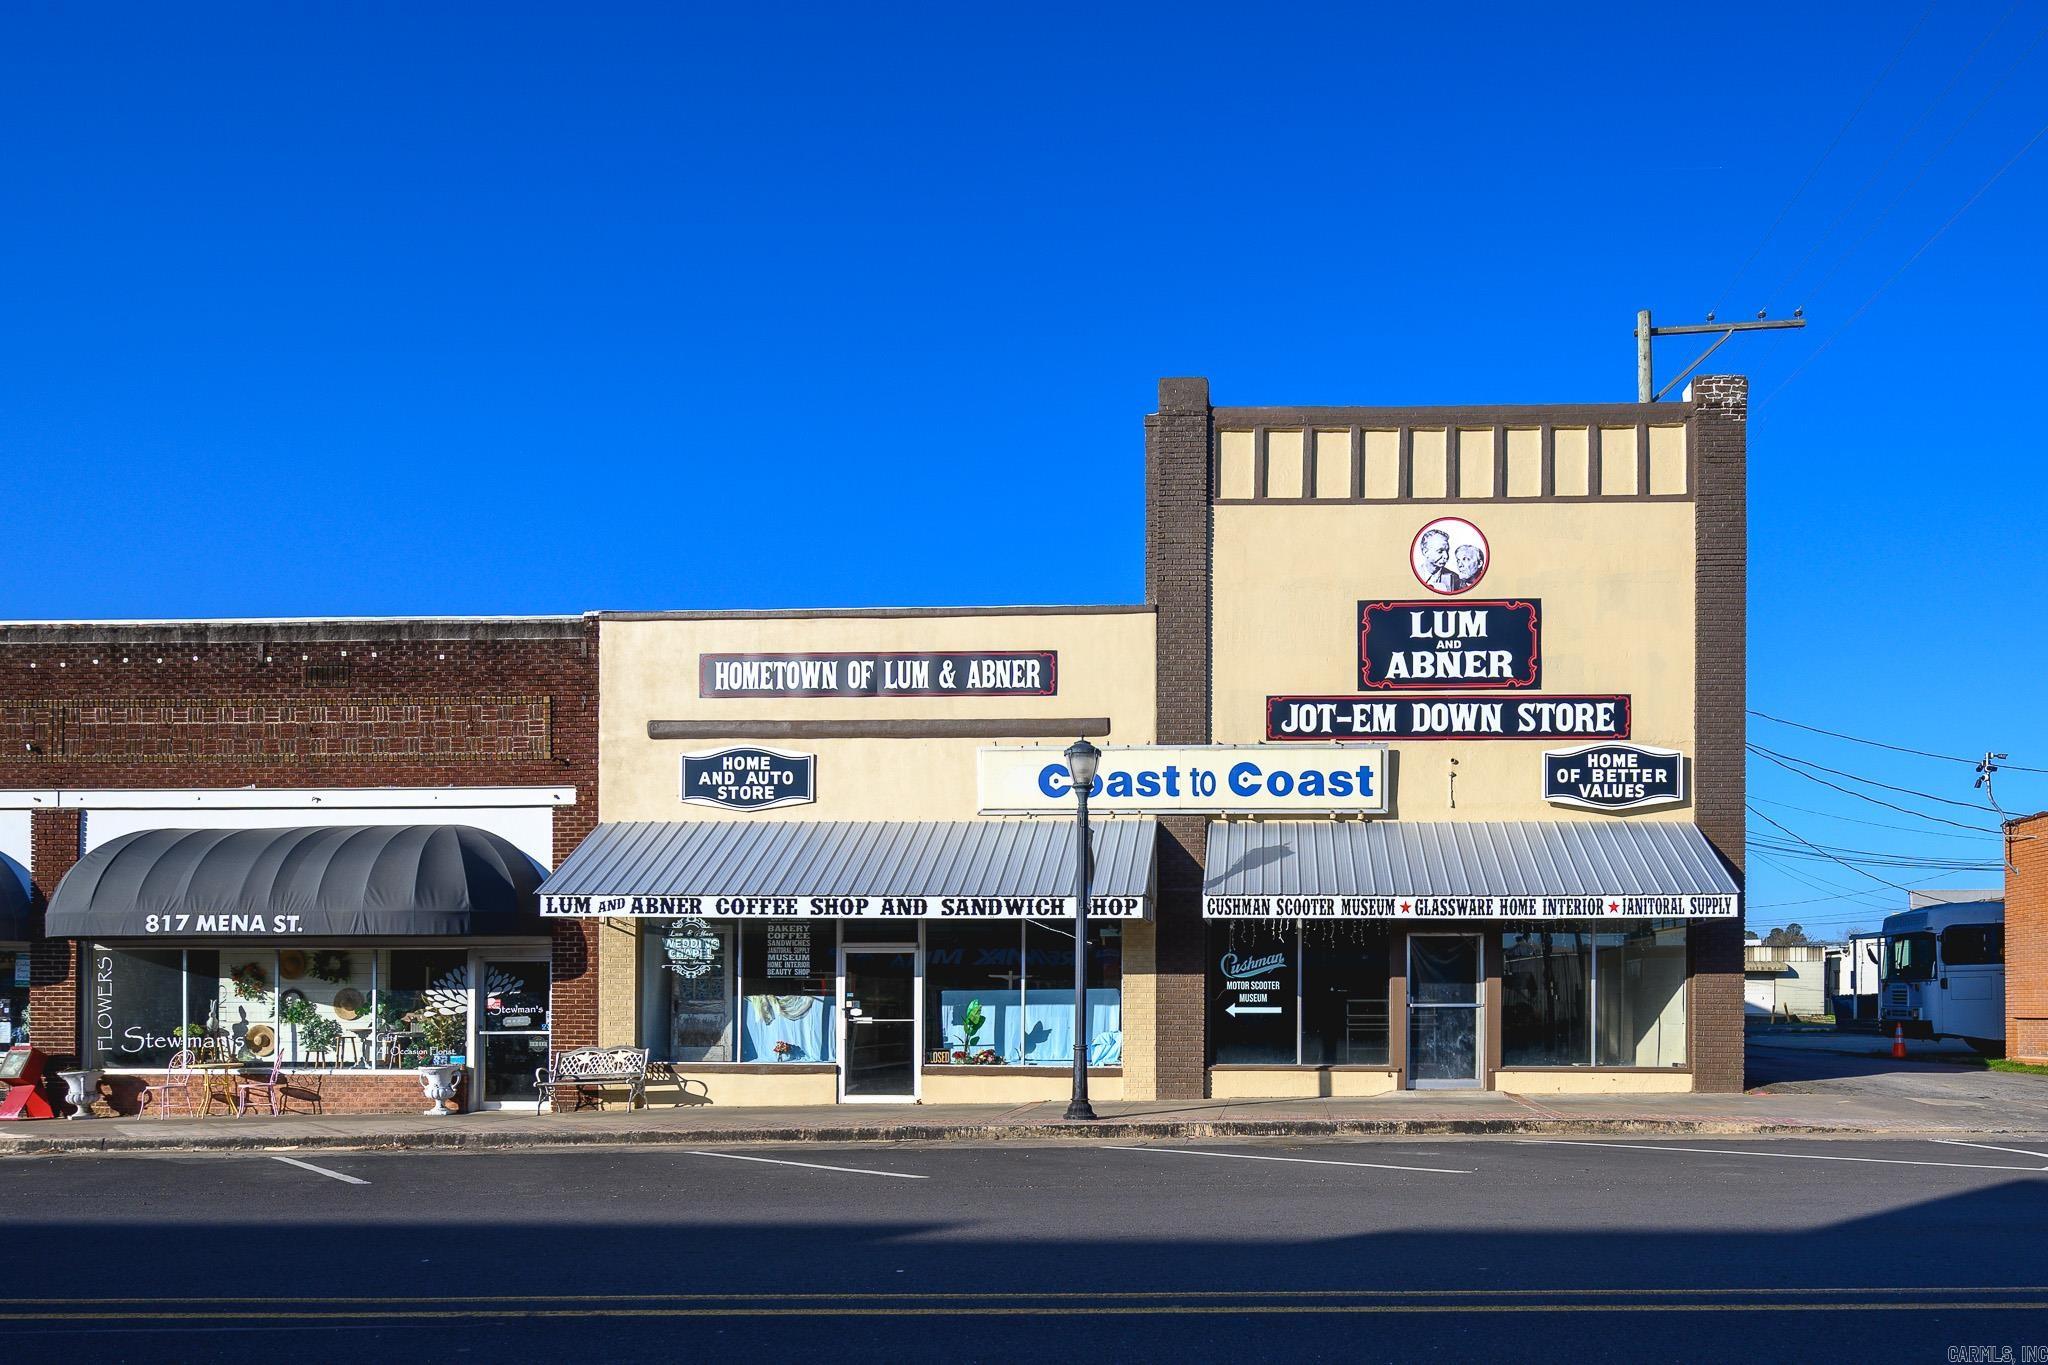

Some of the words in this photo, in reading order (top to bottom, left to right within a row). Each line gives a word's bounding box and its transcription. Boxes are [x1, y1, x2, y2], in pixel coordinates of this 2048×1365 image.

[1410, 611, 1488, 638] LUM
[1436, 640, 1462, 649] AND
[1385, 650, 1514, 679] ABNER
[714, 660, 839, 690] HOMETOWN
[847, 660, 875, 689] OF
[883, 660, 930, 689] LUM
[938, 660, 957, 688] &
[966, 659, 1041, 689] ABNER
[1281, 703, 1398, 733] JOT-EM
[1411, 703, 1504, 733] DOWN
[1517, 703, 1616, 733] STORE
[722, 756, 771, 771] HOME
[1587, 753, 1638, 768] HOME
[698, 771, 735, 785] AND
[745, 771, 794, 785] AUTO
[1190, 768, 1216, 797] to
[1229, 762, 1374, 797] Coast
[1556, 768, 1581, 783] OF
[1592, 768, 1668, 783] BETTER
[717, 785, 775, 800] STORE
[1578, 784, 1645, 798] VALUES
[545, 897, 592, 914] LUM
[597, 898, 626, 913] AND
[629, 897, 703, 914] ABNER
[715, 898, 798, 915] COFFEE
[810, 898, 869, 915] SHOP
[880, 898, 928, 916] AND
[941, 898, 1066, 916] SANDWICH
[1087, 898, 1139, 916] HOP
[1206, 898, 1271, 916] CUSHMAN
[1276, 898, 1335, 916] SCOOTER
[1340, 898, 1396, 916] MUSEUM
[1414, 898, 1494, 916] GLASSWARE
[1499, 898, 1537, 916] HOME
[1542, 898, 1605, 915] INTERIOR
[1622, 897, 1685, 915] JANITORAL
[1689, 897, 1732, 915] SUPPLY
[145, 914, 190, 933] 817
[195, 914, 266, 932] MENA
[272, 914, 303, 933] ST.
[767, 953, 810, 961] MUSEUM
[1220, 951, 1287, 979] Cushman
[1226, 981, 1250, 990] MOTOR
[1250, 981, 1281, 990] SCOOTER
[97, 956, 113, 1051] FLOWERS
[1239, 993, 1268, 1003] MUSEUM
